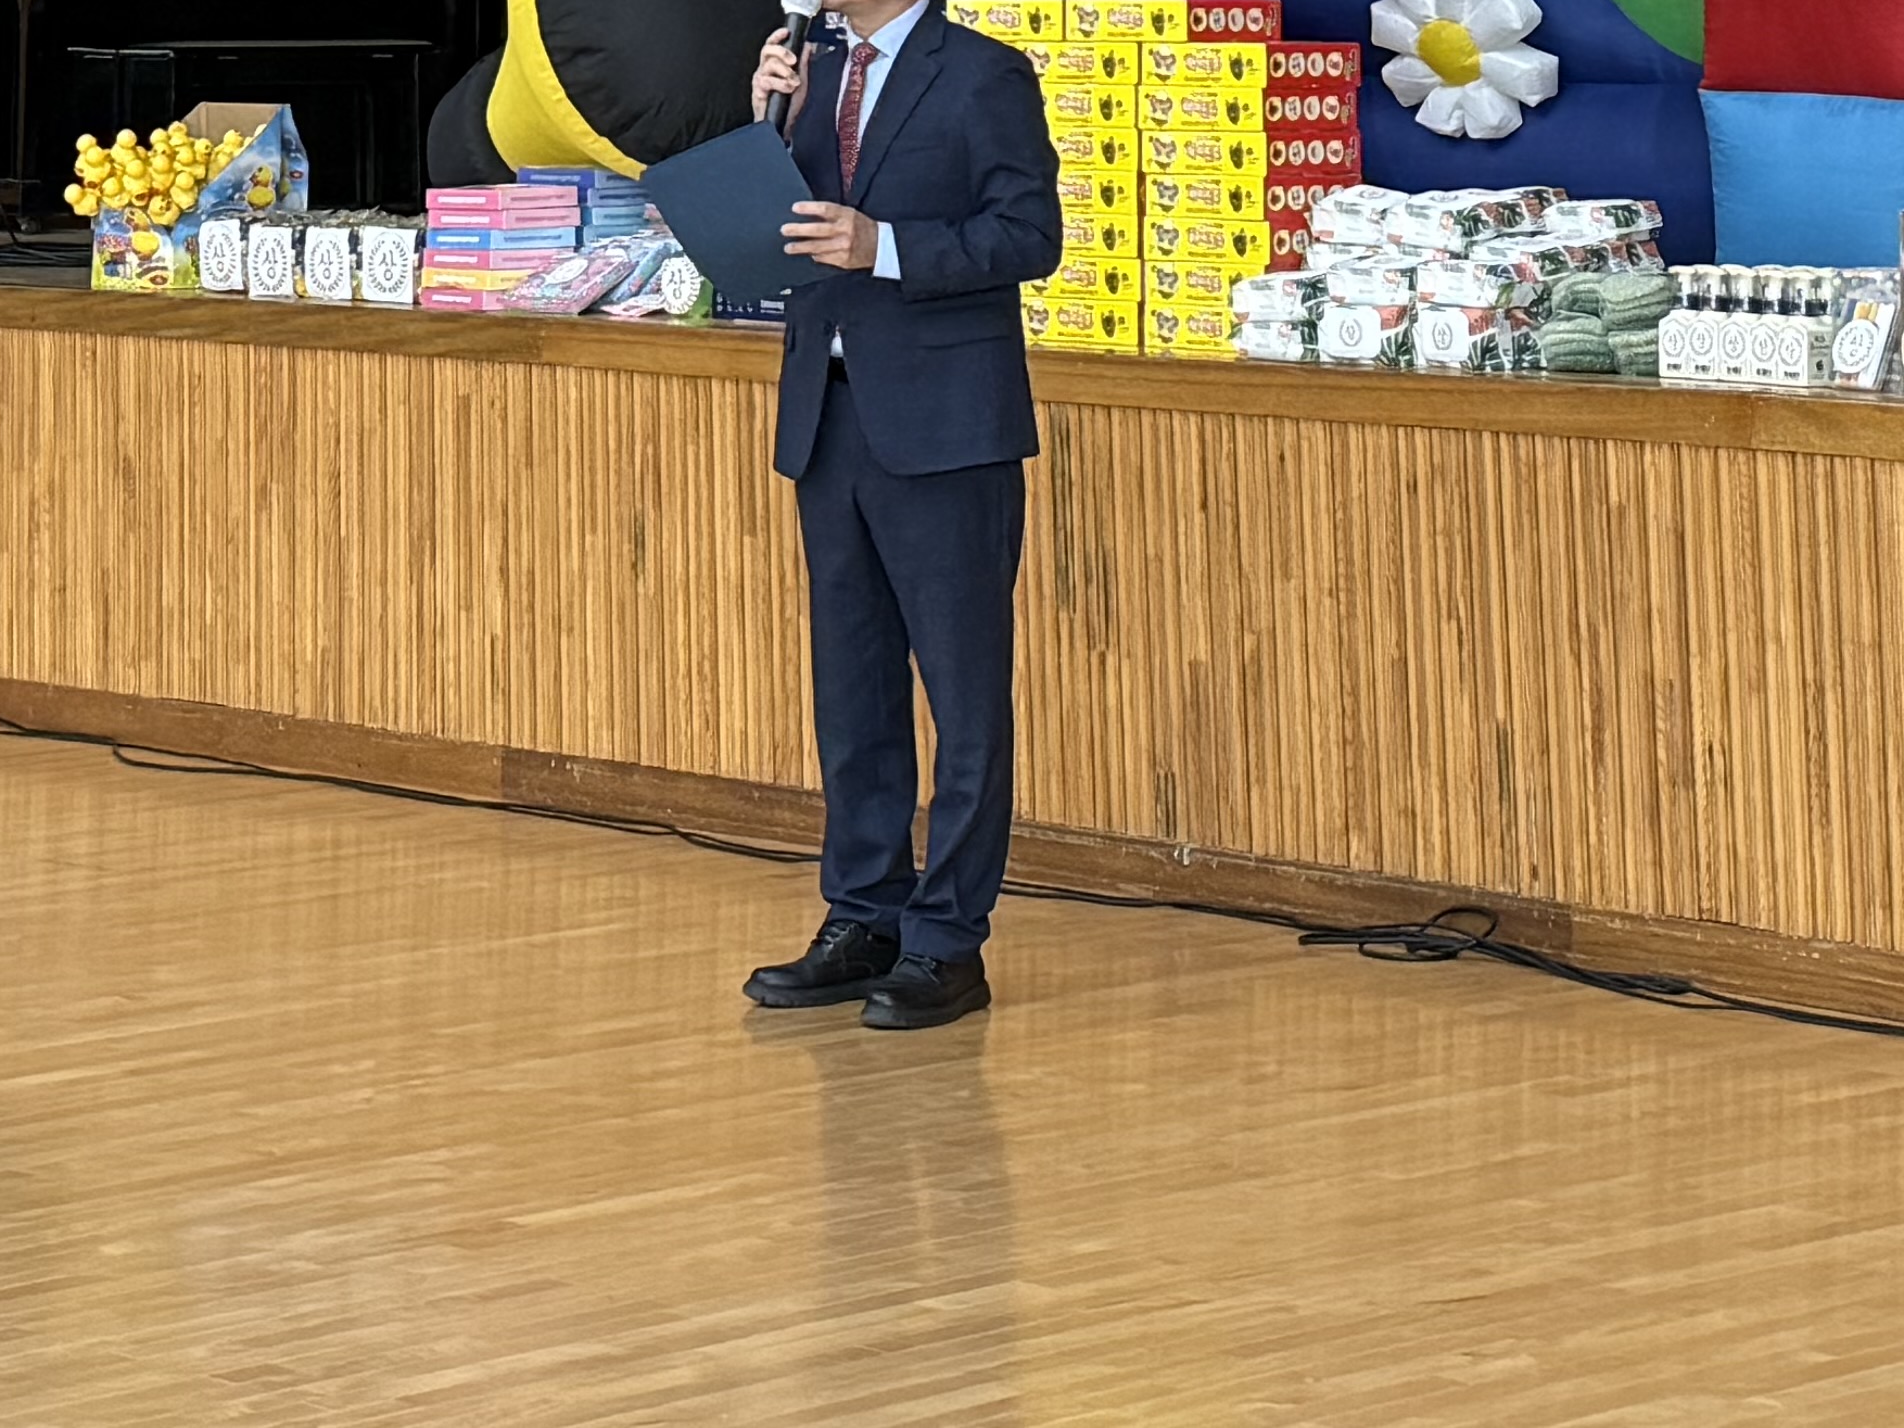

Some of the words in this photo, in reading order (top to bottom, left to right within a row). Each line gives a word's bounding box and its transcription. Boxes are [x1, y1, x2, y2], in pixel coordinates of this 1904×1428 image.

[262, 246, 279, 280] 상
[317, 248, 334, 281] 상
[377, 249, 397, 282] 상
